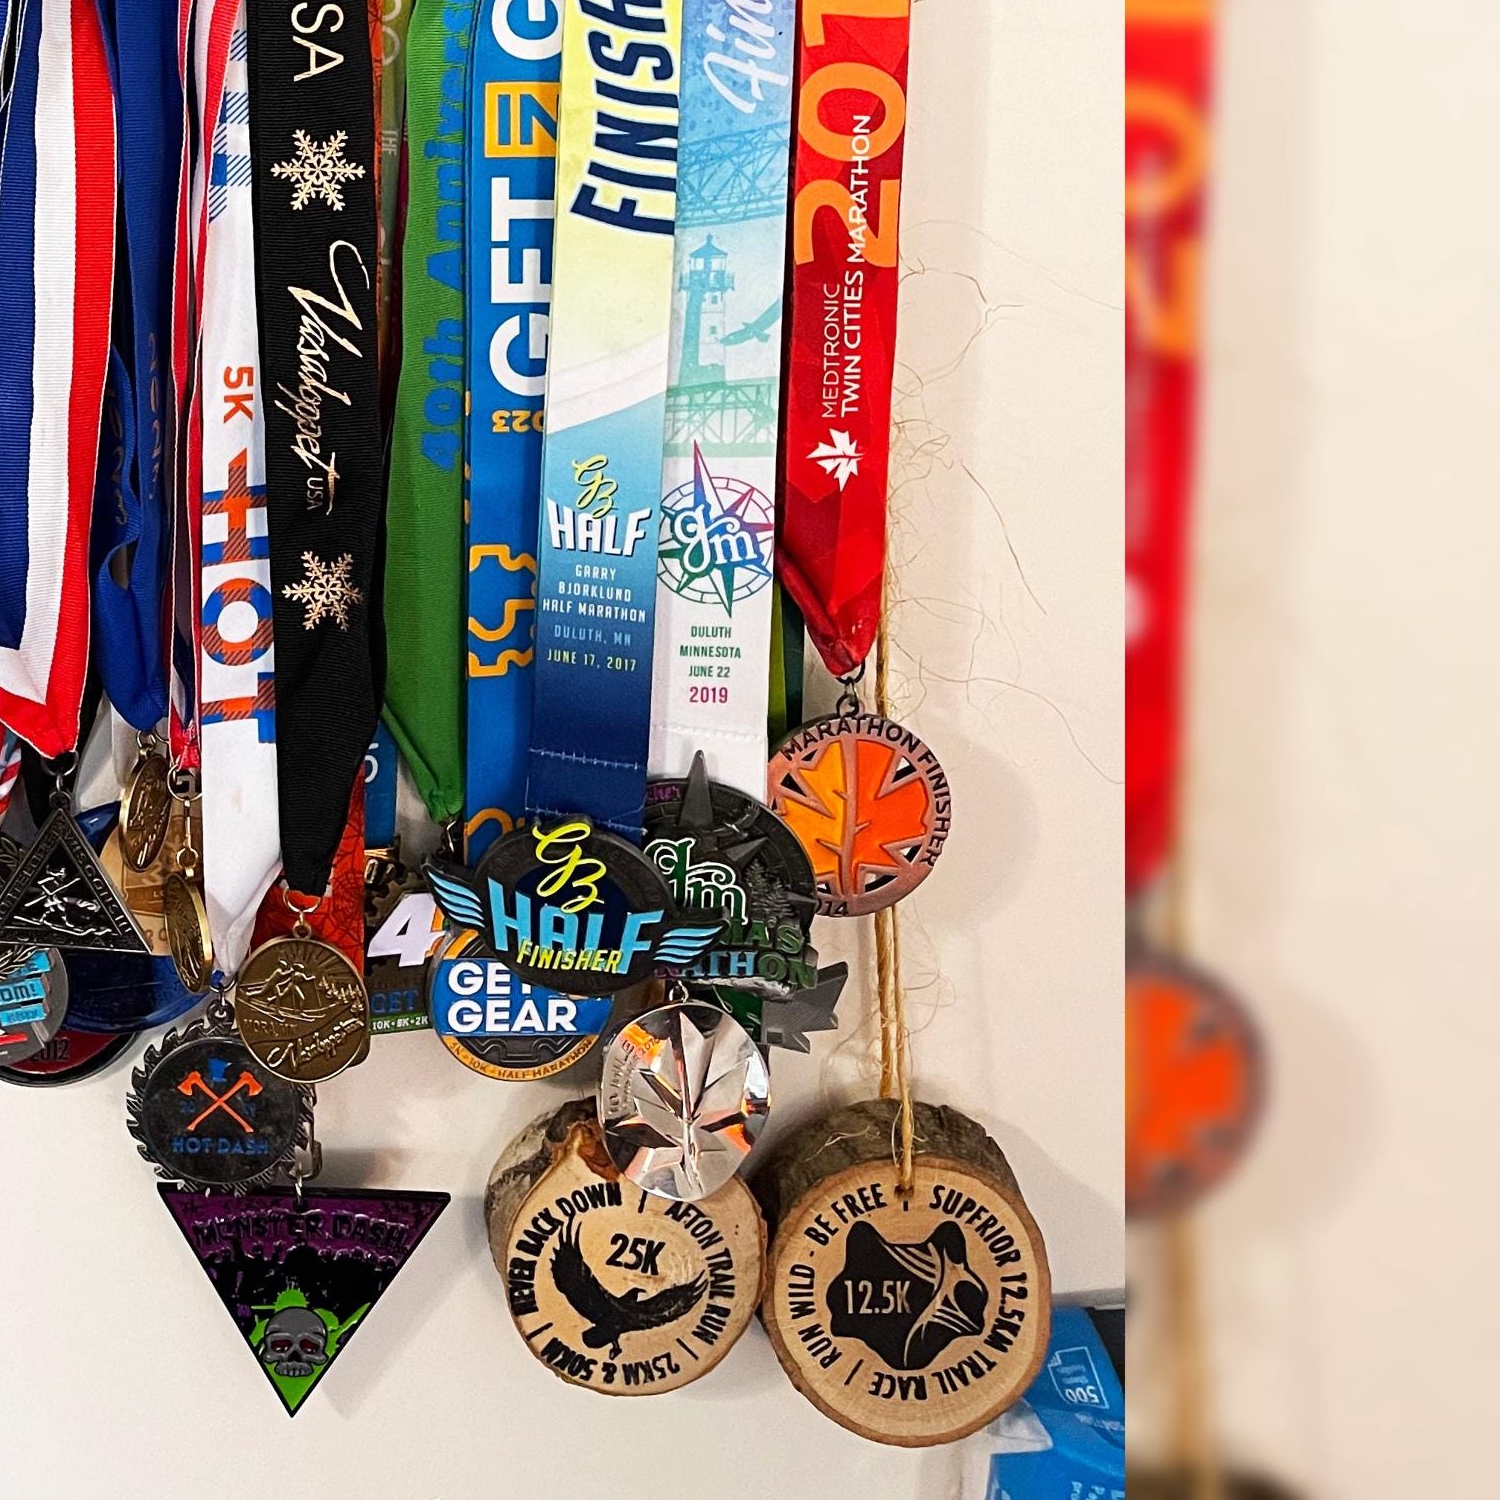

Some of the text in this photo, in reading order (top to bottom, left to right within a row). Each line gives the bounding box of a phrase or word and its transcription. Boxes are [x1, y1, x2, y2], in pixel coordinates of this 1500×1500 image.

[845, 114, 872, 264] MARATHON
[821, 282, 842, 419] MEDTRONIC
[840, 270, 865, 419] TWIN CITIES
[222, 365, 254, 424] 5K
[306, 476, 323, 511] USA
[546, 497, 652, 558] HALF
[575, 563, 618, 581] GARRY
[201, 446, 278, 744] HOT
[558, 581, 632, 602] BJORKLUND
[542, 598, 647, 624] HALF MARATHON
[613, 630, 632, 647] MN
[690, 625, 733, 639] DULUTH
[546, 648, 638, 672] JUNE 17, 2017
[679, 644, 742, 659] MINNESOTA
[688, 664, 731, 678] JUNE 22
[688, 685, 730, 704] 2019
[779, 715, 952, 868] MARATHON FINISHER
[487, 875, 665, 975] HALF
[515, 938, 624, 974] FINISHER
[446, 997, 578, 1034] GEAR
[171, 1135, 269, 1156] HOT DASH
[508, 1181, 623, 1317] NEVER BACK DOWN
[604, 1232, 667, 1277] 25K
[663, 1200, 736, 1346] AFTON TRAIL RUN
[788, 1182, 889, 1372] RUN WILD BE FREE
[843, 1278, 912, 1315] 12.5K
[867, 1184, 1029, 1402] SUPERIOR 12.5KM TRAIL RACE
[540, 1336, 599, 1382] 50KM
[621, 1351, 682, 1387] 25KM
[1064, 1384, 1101, 1404] 500
